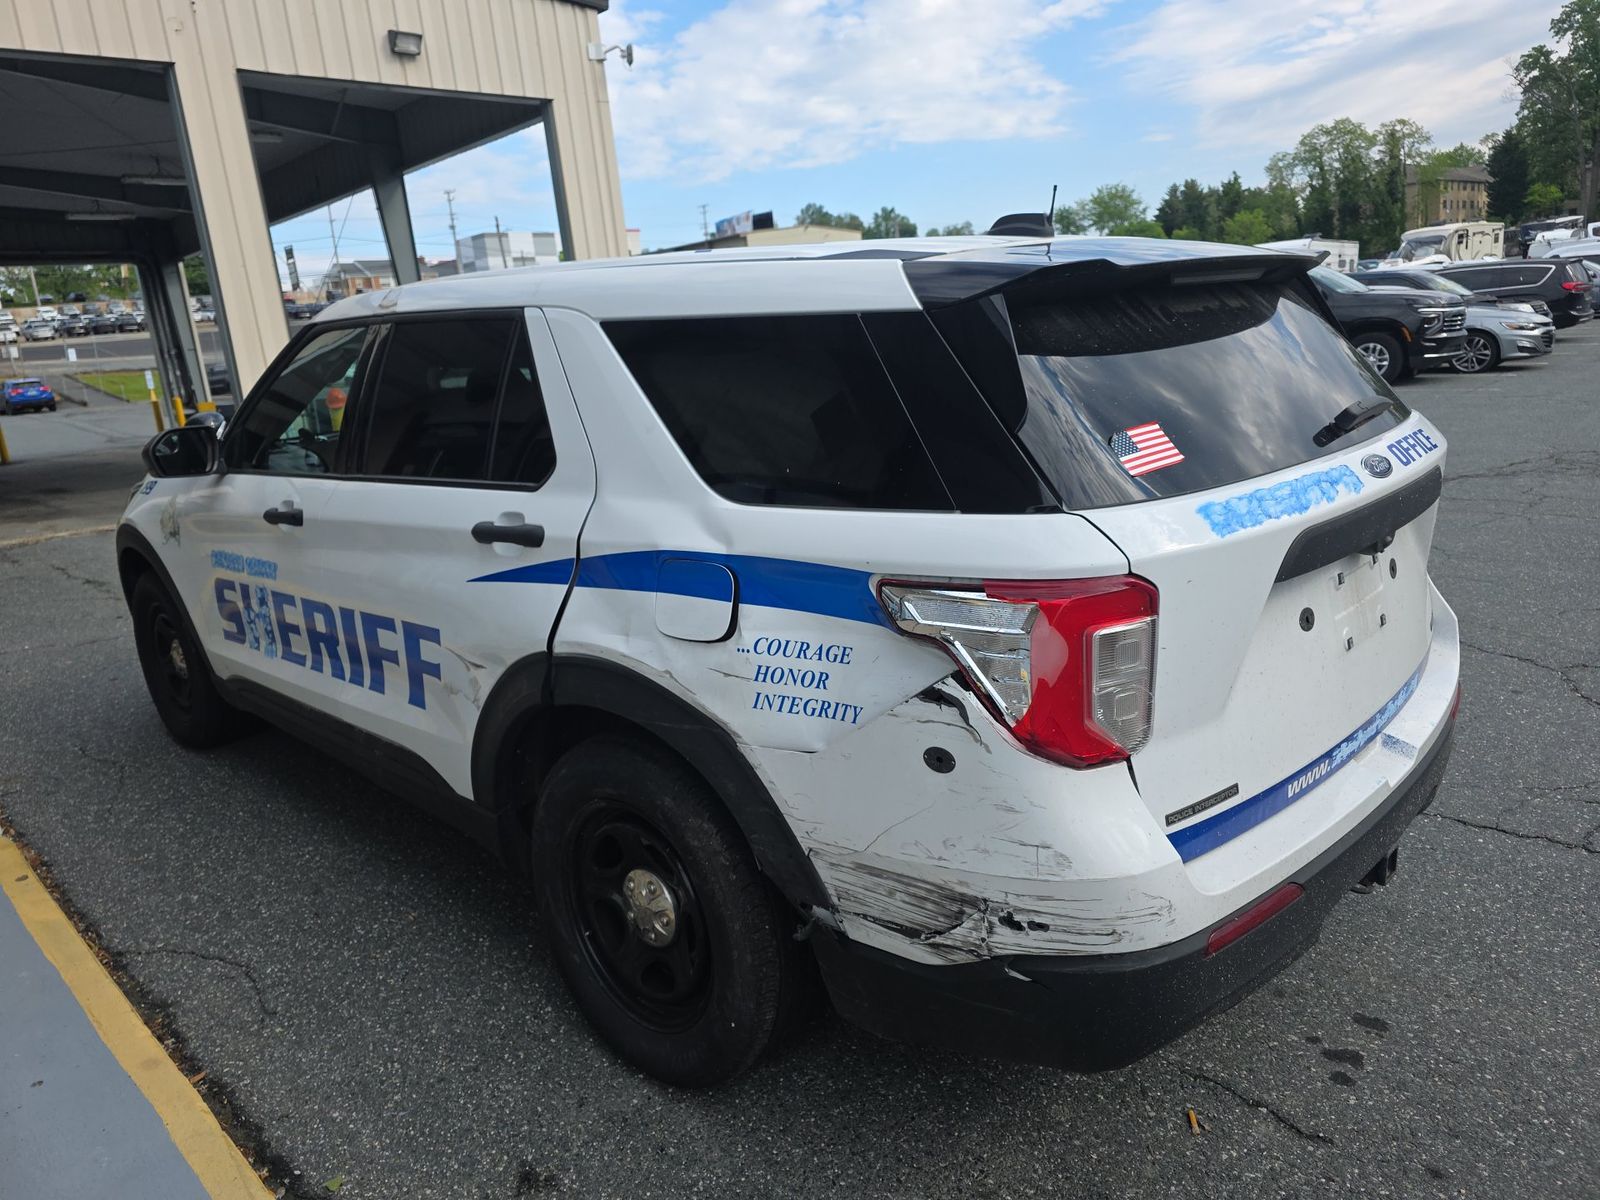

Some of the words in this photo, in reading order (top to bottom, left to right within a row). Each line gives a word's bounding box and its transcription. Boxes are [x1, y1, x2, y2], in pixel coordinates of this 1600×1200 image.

[1386, 428, 1438, 467] OFFICE
[1370, 459, 1390, 473] Ford
[753, 664, 830, 690] HONOR
[752, 691, 864, 725] INTEGRITY
[1168, 808, 1194, 823] POLICE
[1194, 786, 1238, 813] INTERCEPTOR
